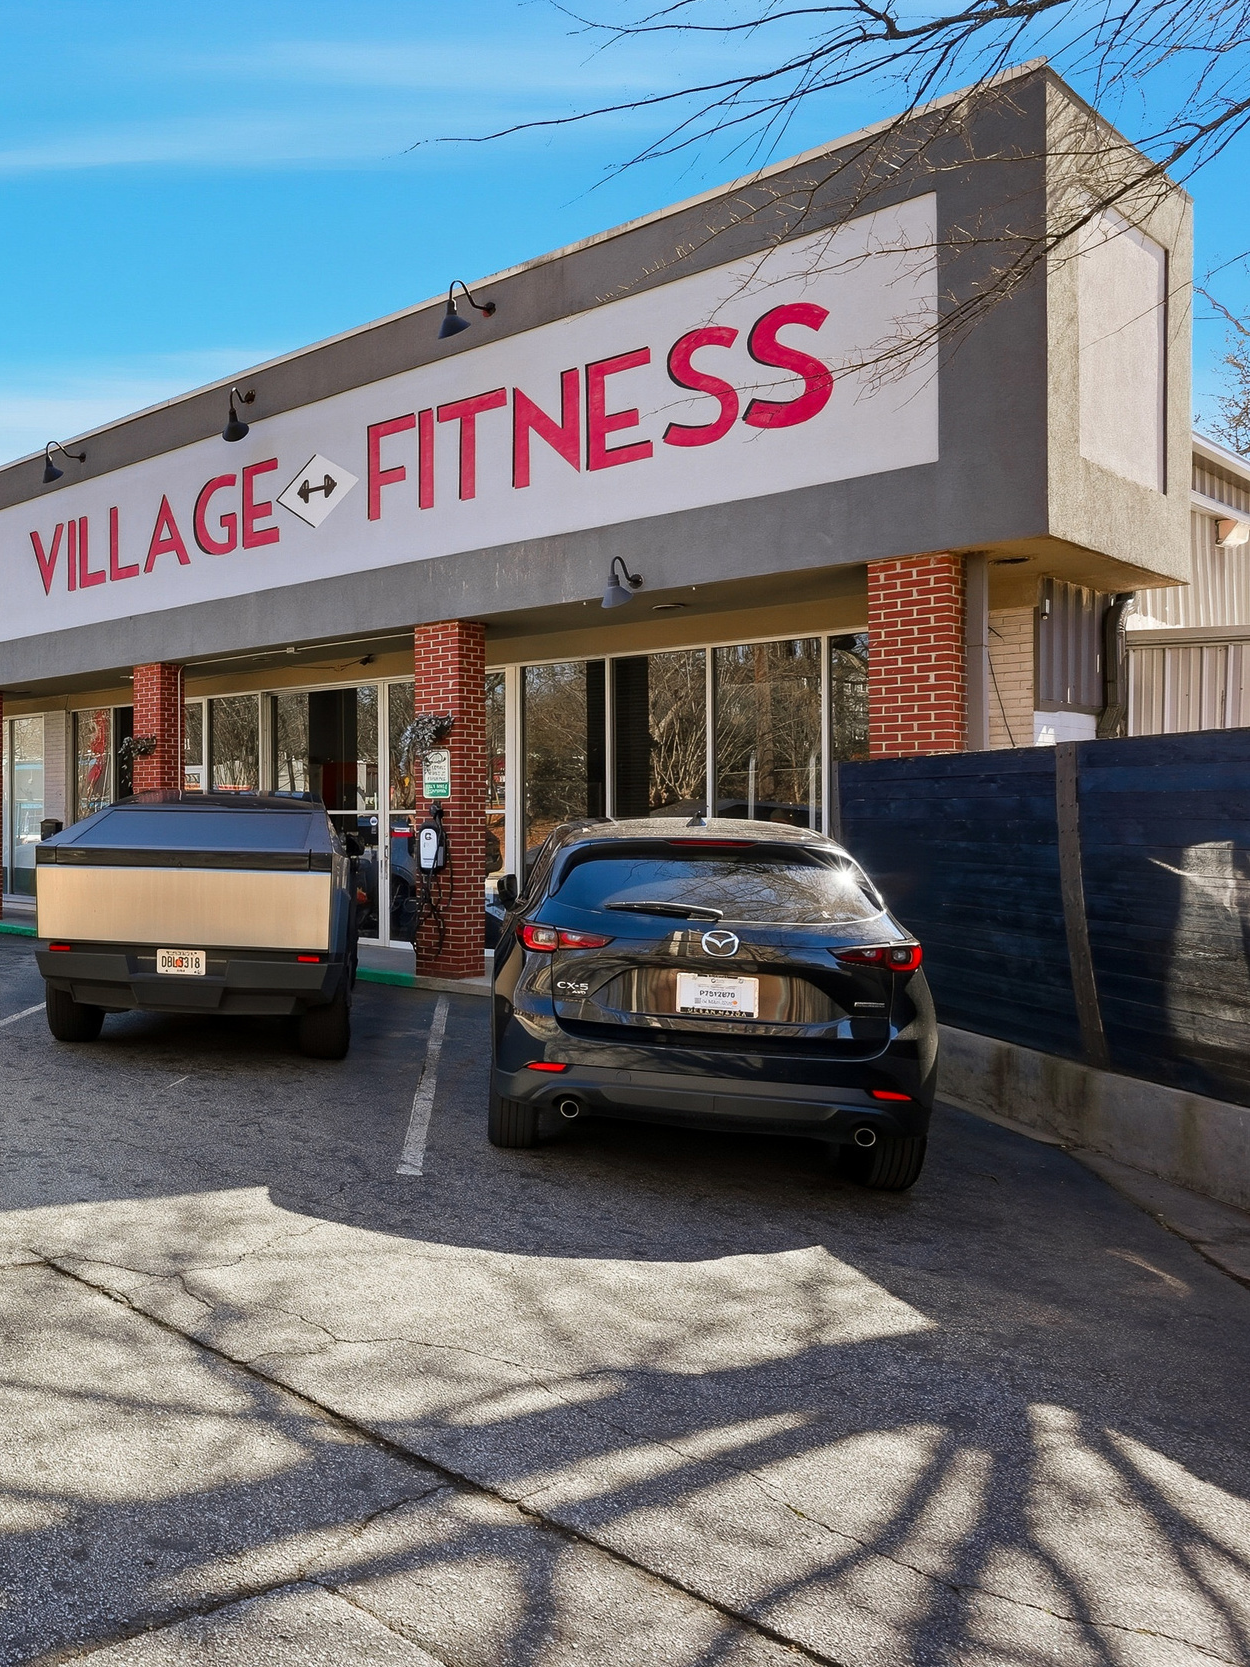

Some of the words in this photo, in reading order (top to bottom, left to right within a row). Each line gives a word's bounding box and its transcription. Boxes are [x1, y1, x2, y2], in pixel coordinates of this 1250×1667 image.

[29, 457, 281, 596] VILLAGE
[366, 301, 835, 522] FITNESS
[556, 981, 589, 991] CX-5
